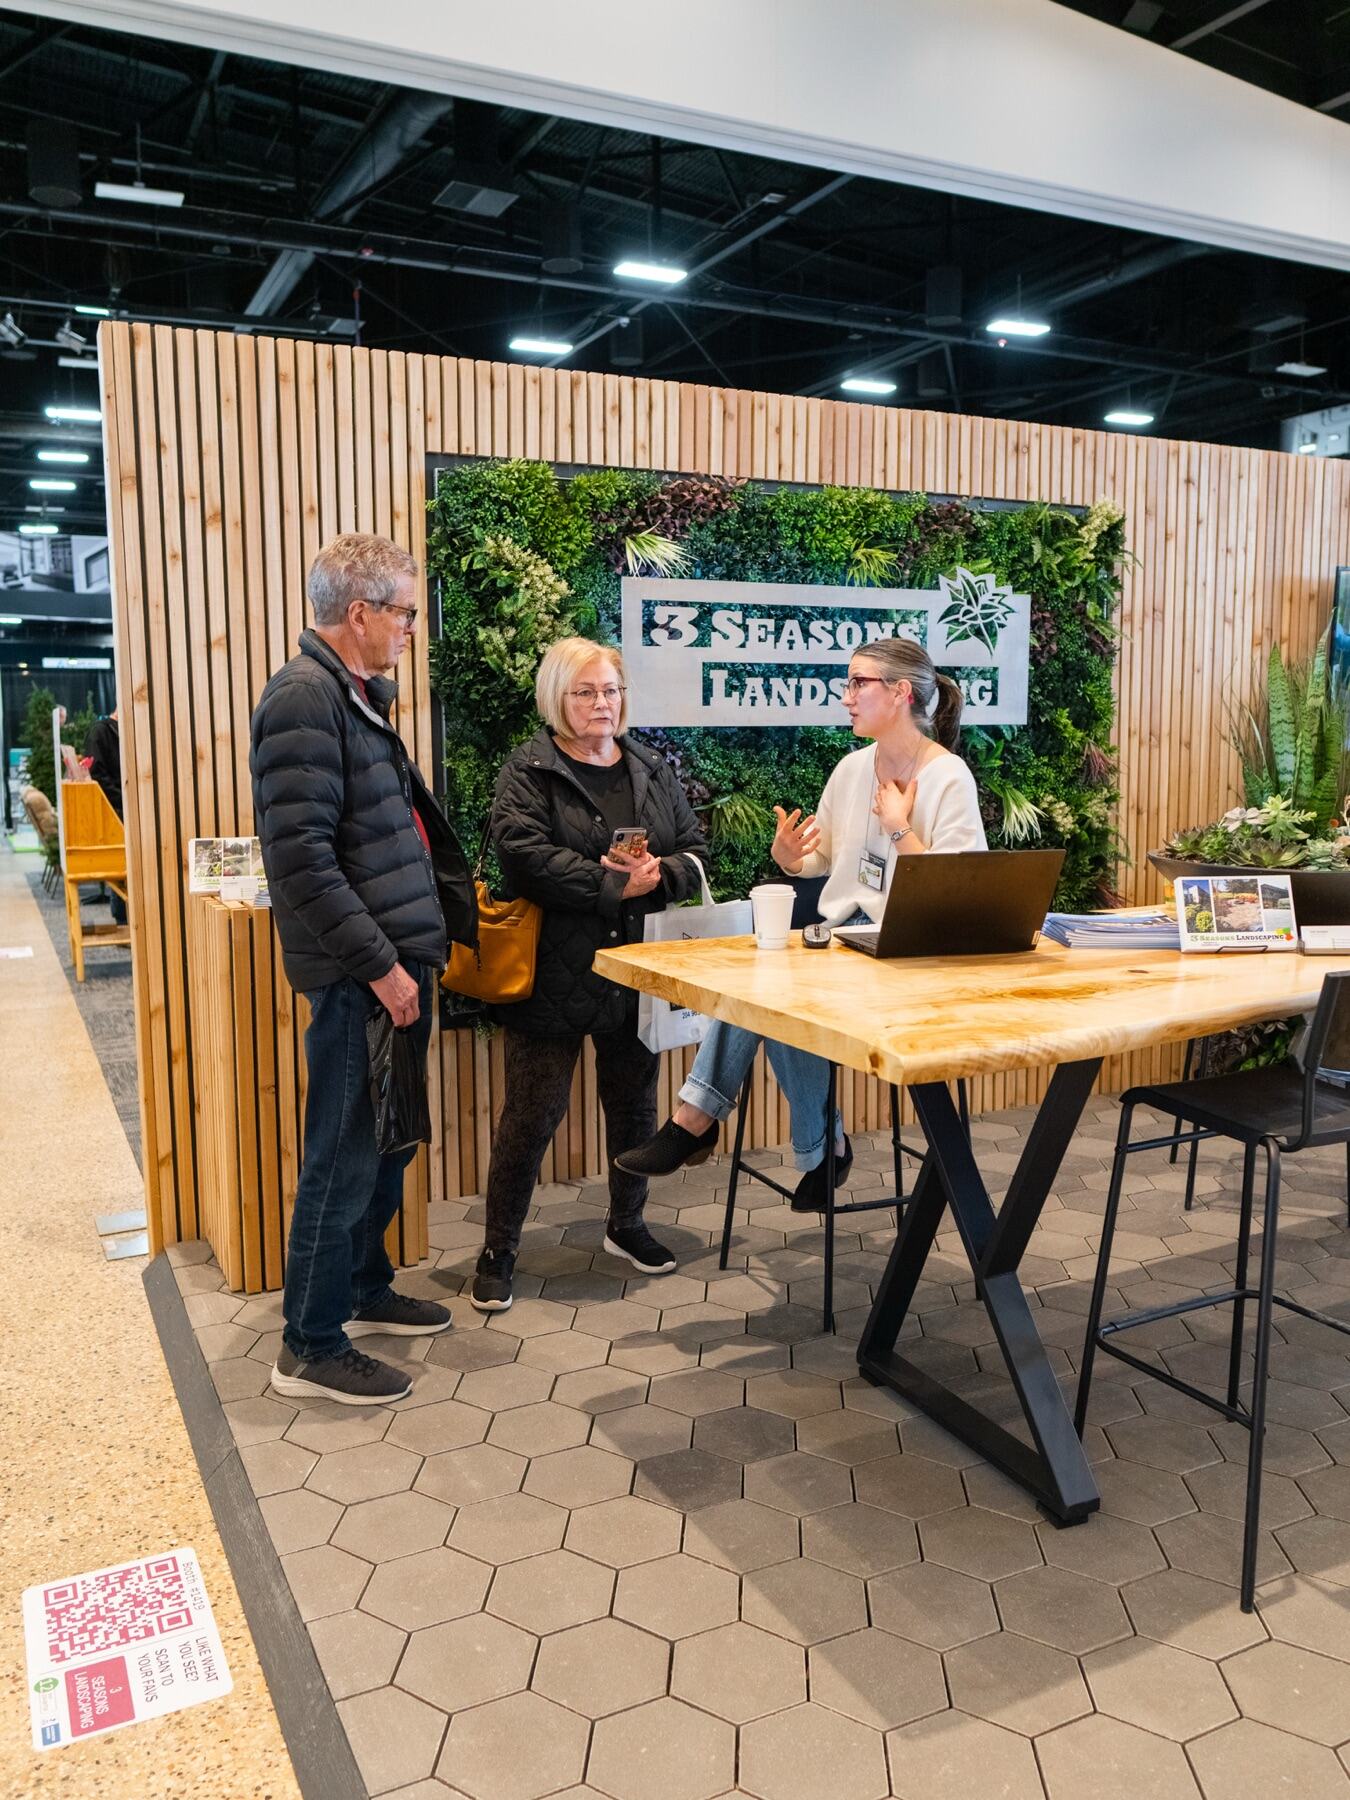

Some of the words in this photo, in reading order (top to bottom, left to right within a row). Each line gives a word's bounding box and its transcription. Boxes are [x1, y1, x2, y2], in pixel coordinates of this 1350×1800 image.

[650, 606, 700, 647] 3
[710, 610, 922, 650] SEASONS
[709, 669, 993, 706] LANDSG
[178, 1640, 192, 1660] YOU
[195, 1636, 211, 1658] LIKE
[137, 1652, 152, 1678] YOUR
[155, 1648, 169, 1675] SCAN
[162, 1675, 174, 1687] TO
[183, 1660, 199, 1682] SEE?
[201, 1656, 219, 1683] WHAT
[74, 1672, 95, 1728] LANDSCAPING
[91, 1676, 109, 1714] SEASONS
[109, 1686, 122, 1694] 3
[143, 1677, 158, 1703] FAVS
